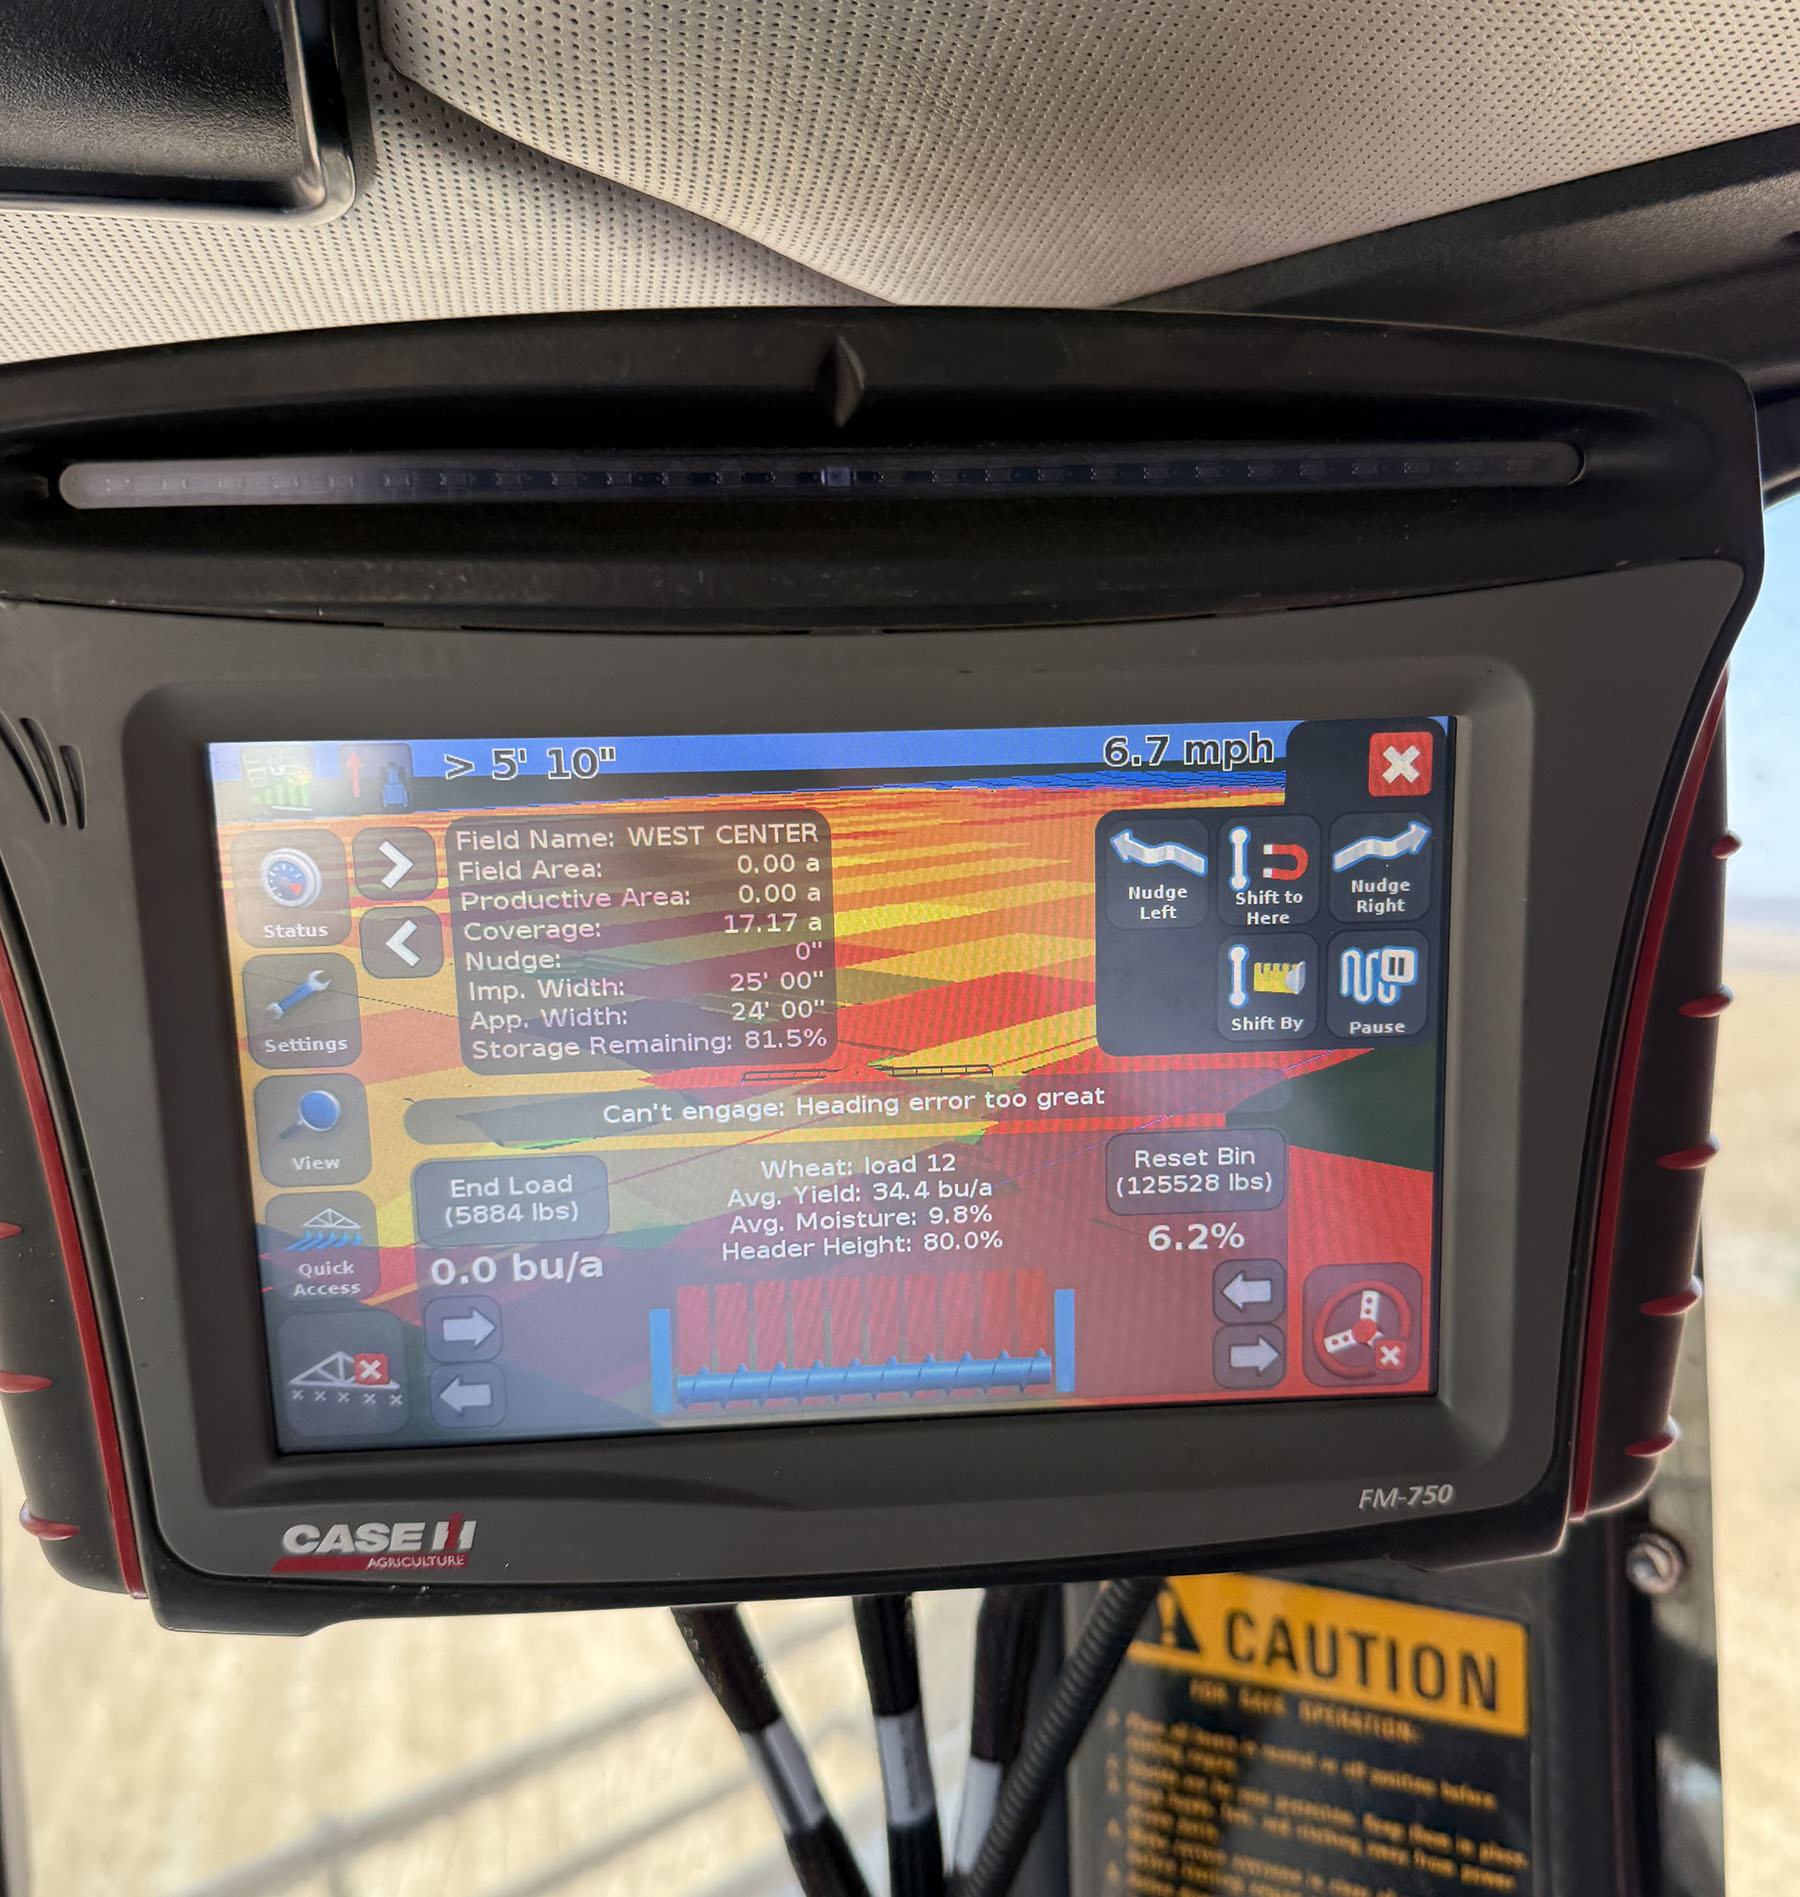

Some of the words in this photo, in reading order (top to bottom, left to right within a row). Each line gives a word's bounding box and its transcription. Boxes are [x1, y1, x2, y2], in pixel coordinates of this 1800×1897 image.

[491, 748, 528, 782] 5'
[546, 745, 618, 780] 10"
[1103, 735, 1170, 767] 6.7
[1183, 731, 1275, 772] mph
[456, 829, 520, 851] Field
[530, 828, 614, 850] Name:
[627, 825, 705, 847] WEST
[716, 822, 819, 845] CENTER
[458, 859, 522, 882] Field
[531, 859, 602, 880] Area:
[737, 853, 796, 874] 0.00
[806, 857, 820, 873] a
[460, 888, 612, 912] Productive
[621, 887, 690, 908] Area:
[739, 883, 797, 904] 0.00
[807, 886, 821, 902] a
[1128, 884, 1188, 903] Nudge
[1235, 891, 1279, 906] Shift
[1285, 891, 1303, 904] to
[1351, 878, 1411, 896] Nudge
[1140, 905, 1177, 921] Left
[1247, 910, 1291, 926] Here
[1356, 898, 1406, 916] Right
[263, 922, 328, 940] Status
[464, 921, 601, 943] Coverage:
[724, 912, 798, 934] 17.17
[808, 915, 822, 932] a
[465, 950, 561, 974] Nudge:
[795, 941, 823, 961] 0"
[469, 981, 526, 1004] Imp.
[537, 977, 625, 999] Width:
[730, 971, 768, 992] 25'
[780, 970, 824, 991] 00"
[469, 1010, 528, 1034] App.
[540, 1006, 628, 1028] Width:
[731, 1001, 770, 1021] 24'
[781, 999, 825, 1019] 00"
[1231, 1016, 1276, 1031] Shift
[1280, 1015, 1304, 1033] By
[1349, 1020, 1405, 1034] Pause
[264, 1034, 348, 1055] Settings
[472, 1040, 580, 1061] Storage
[589, 1032, 732, 1055] Remaining:
[744, 1028, 827, 1049] 81.5%
[603, 1103, 673, 1125] Can't
[682, 1100, 785, 1127] engage:
[796, 1096, 900, 1121] Heading
[908, 1092, 975, 1113] error
[984, 1090, 1028, 1109] too
[1037, 1086, 1106, 1111] great
[292, 1155, 341, 1172] View
[760, 1157, 853, 1179] Wheat:
[865, 1155, 917, 1175] load
[927, 1153, 957, 1173] 12
[1134, 1149, 1208, 1169] Reset
[1217, 1146, 1256, 1166] Bin
[450, 1177, 500, 1199] End
[509, 1174, 573, 1196] Load
[727, 1187, 782, 1210] Avg.
[795, 1184, 862, 1205] Yield:
[872, 1181, 931, 1201] 34.4
[937, 1178, 993, 1200] bu/a
[1116, 1173, 1221, 1198] (125528
[1229, 1171, 1273, 1193] lbs)
[444, 1203, 525, 1228] (5884
[532, 1199, 579, 1224] lbs)
[729, 1214, 784, 1237] Avg.
[795, 1209, 917, 1231] Moisture:
[928, 1204, 993, 1226] 9.8%
[722, 1241, 815, 1262] Header
[823, 1236, 913, 1261] Height:
[923, 1231, 1004, 1252] 80.0%
[1148, 1222, 1245, 1251] 6.2%
[298, 1260, 355, 1279] Quick
[430, 1256, 498, 1286] 0.0
[512, 1252, 604, 1284] bu/a
[293, 1280, 361, 1297] Access
[1358, 1484, 1453, 1509] FM-750
[282, 1521, 426, 1554] CASE
[367, 1554, 465, 1570] AGRICULTURE
[1224, 1609, 1498, 1713] CAUTION
